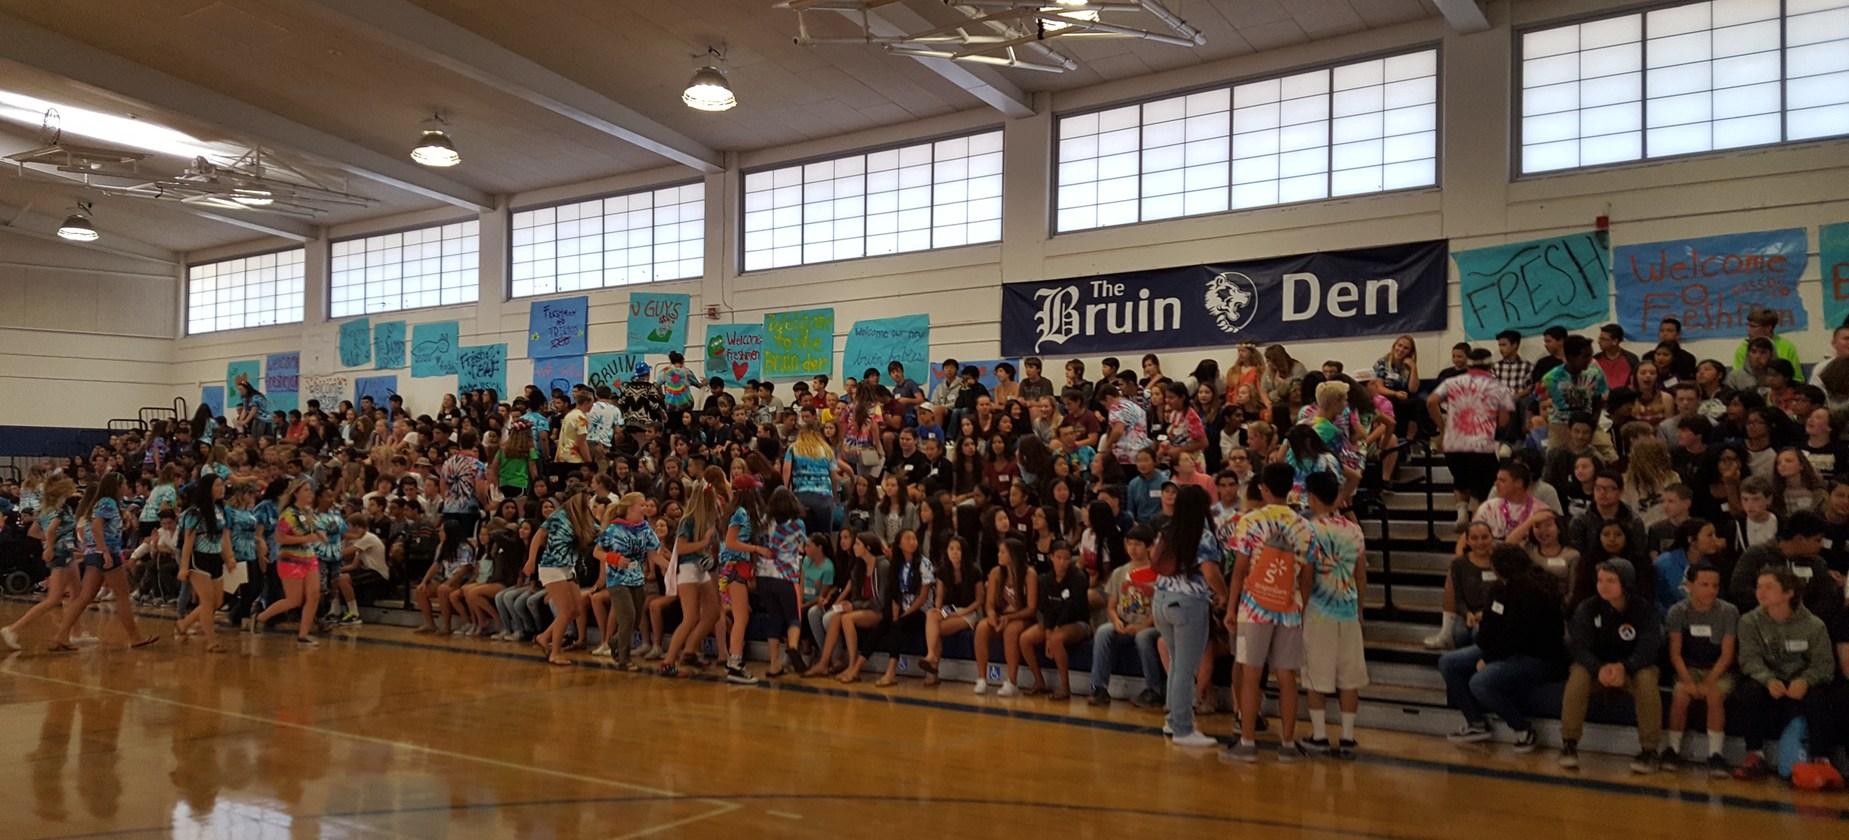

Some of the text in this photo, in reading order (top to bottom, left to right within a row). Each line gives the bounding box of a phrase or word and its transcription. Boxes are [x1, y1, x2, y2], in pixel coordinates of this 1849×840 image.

[1466, 236, 1609, 329] FRESH
[1630, 248, 1788, 283] Welcome
[1090, 281, 1126, 299] The
[1282, 272, 1399, 322] Den
[644, 299, 682, 320] GUYS
[1034, 285, 1182, 353] Bruin
[589, 354, 637, 388] BRUIN
